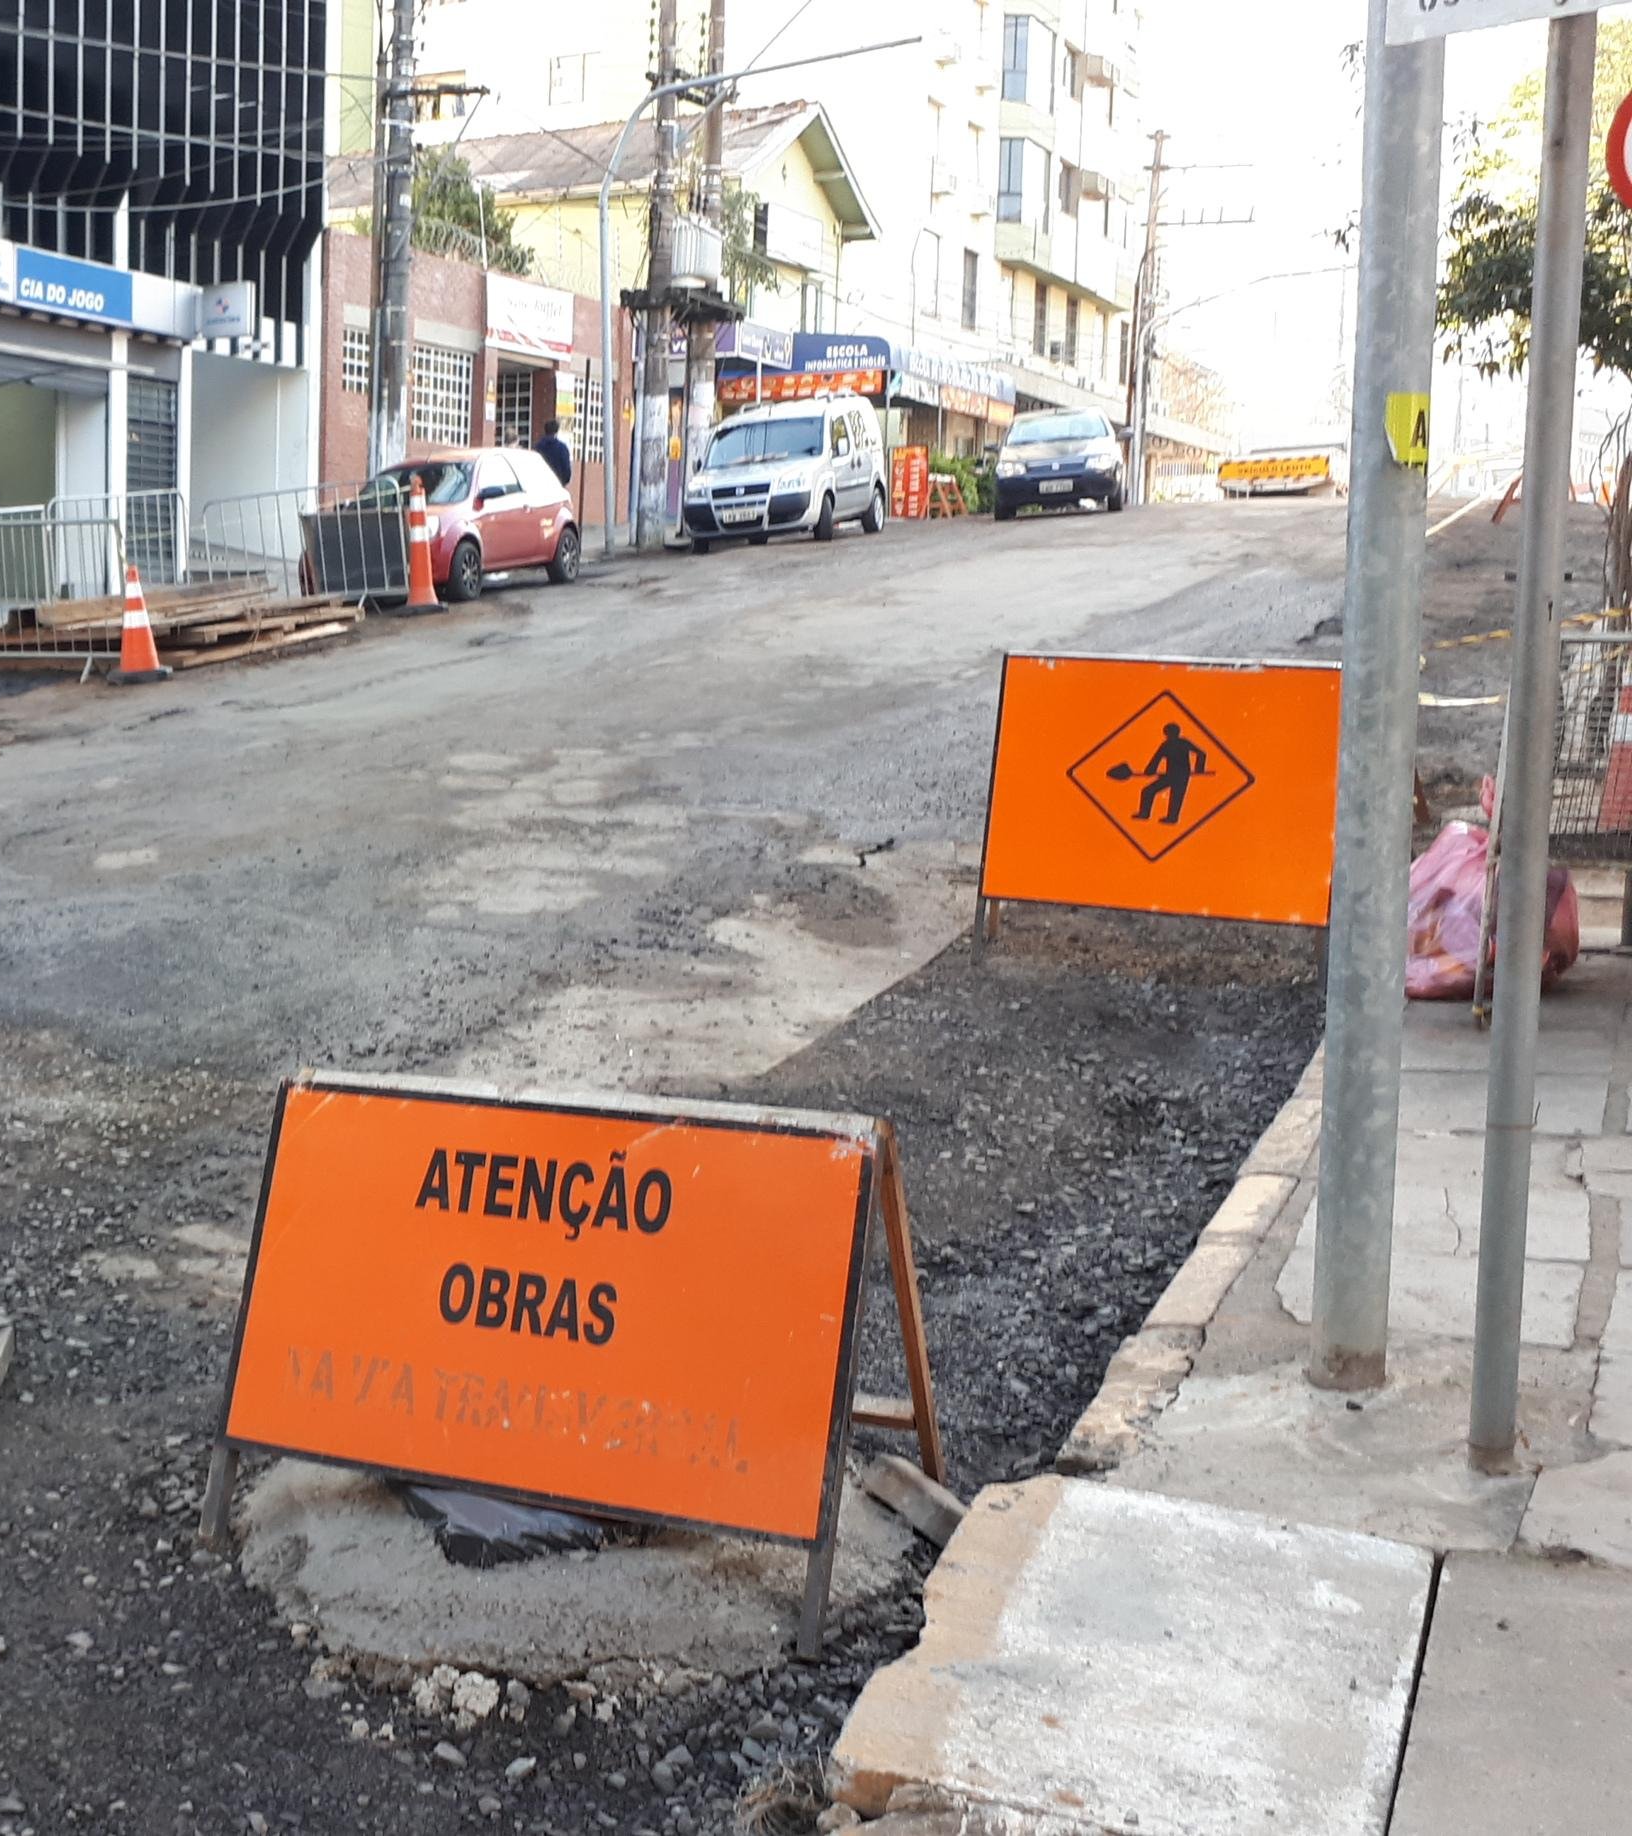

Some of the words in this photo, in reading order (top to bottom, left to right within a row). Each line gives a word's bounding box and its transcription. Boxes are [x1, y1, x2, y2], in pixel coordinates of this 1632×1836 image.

[20, 277, 43, 301] CIA
[46, 282, 66, 305] DO
[67, 288, 105, 313] JOGO
[825, 343, 869, 360] ESCOLA
[415, 1147, 673, 1240] ATENÇÃO
[439, 1261, 618, 1346] OBRAS
